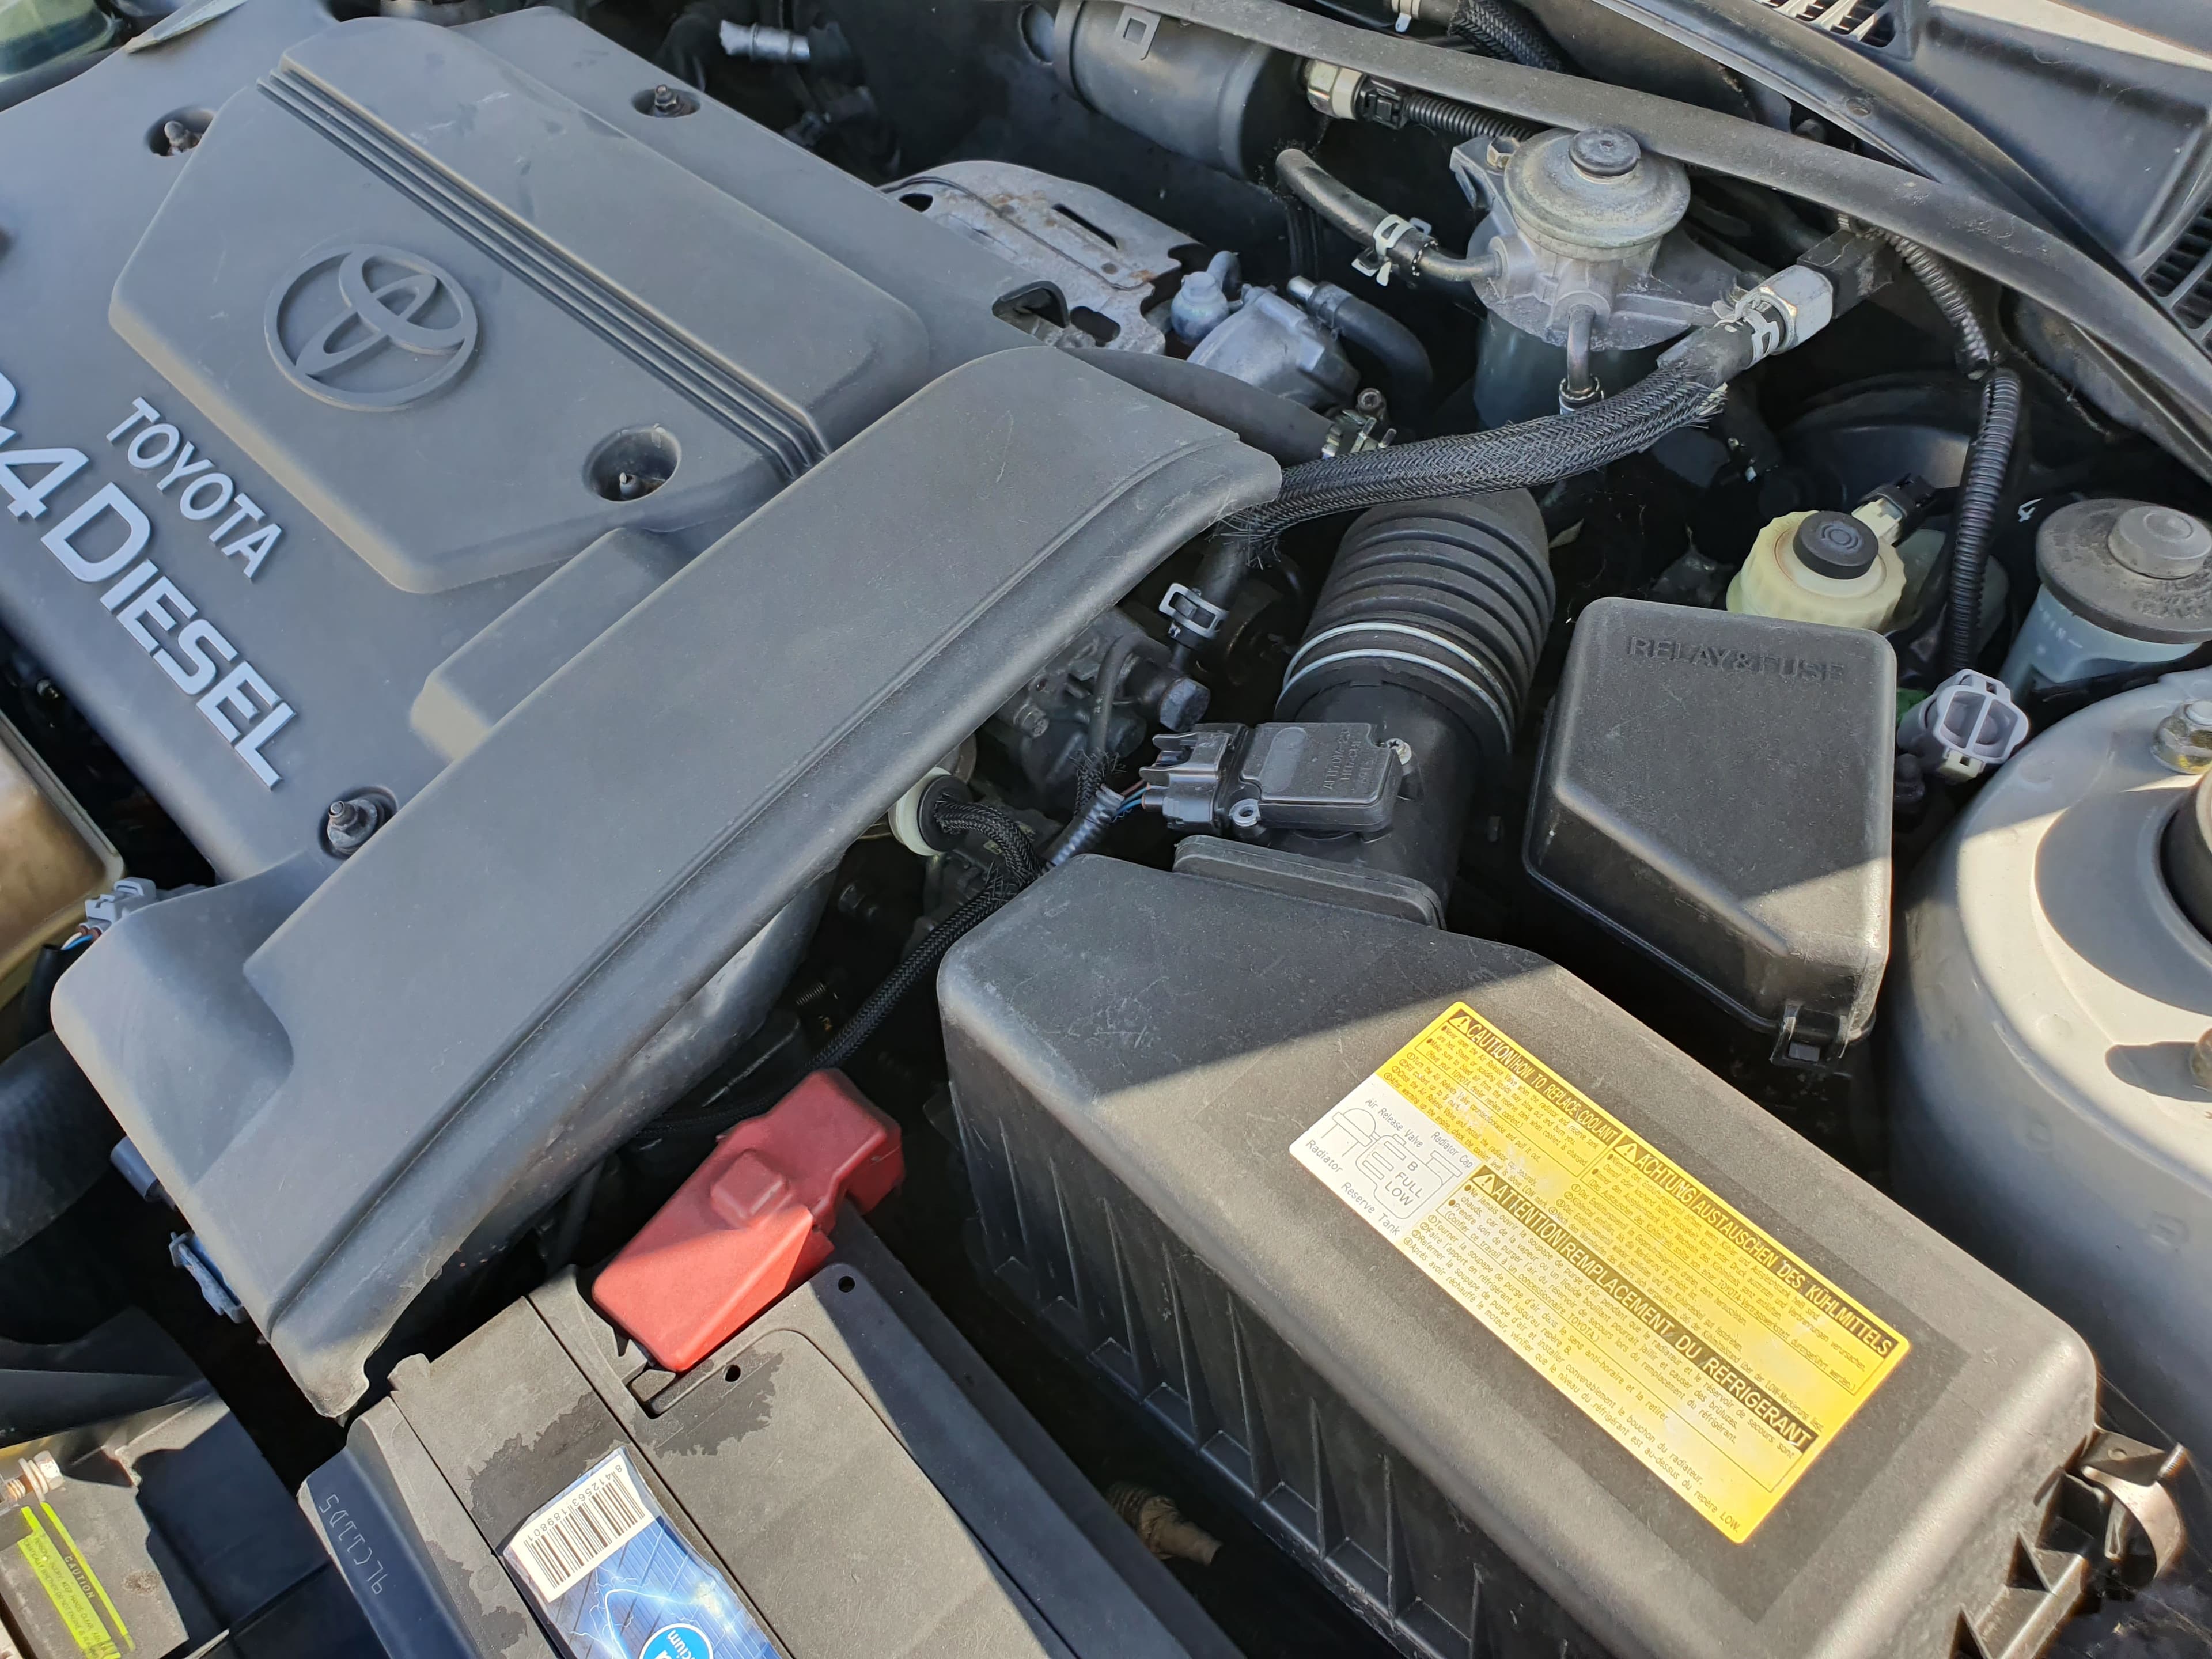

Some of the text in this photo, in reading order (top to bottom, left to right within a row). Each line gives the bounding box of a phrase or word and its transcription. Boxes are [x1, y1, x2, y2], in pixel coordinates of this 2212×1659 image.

[106, 397, 282, 579] TOYOTA
[41, 482, 297, 790] DIESEL
[1364, 1097, 1426, 1148] Air Release Valve
[1464, 1022, 1618, 1143] CAUTION HOW TO REPLACE COOLANT
[1305, 1139, 1345, 1174] Radiator
[1340, 1181, 1403, 1236] Reserve Tank
[1384, 1181, 1414, 1207] LOW
[1394, 1171, 1426, 1199] FULL
[1406, 1160, 1419, 1172] B
[1430, 1131, 1475, 1169] Radiator Cap
[1425, 1227, 1444, 1244] Faire
[1467, 1264, 1478, 1274] en
[1476, 1271, 1514, 1305] réfrigérant
[1539, 1325, 1565, 1348] repère
[1433, 1219, 1460, 1243] Tourner
[1459, 1241, 1468, 1250] la
[1466, 1249, 1494, 1274] soupape
[1494, 1271, 1505, 1281] de
[1503, 1281, 1524, 1299] purge
[1524, 1297, 1541, 1313] d'air
[1540, 1311, 1559, 1328] dans
[1558, 1325, 1568, 1335] le
[1567, 1335, 1584, 1350] sens
[1624, 1382, 1635, 1393] et
[1635, 1391, 1645, 1401] la
[1452, 1202, 1478, 1224] Prendre
[1476, 1222, 1492, 1236] soin
[1491, 1235, 1502, 1245] de
[1500, 1244, 1523, 1264] purger
[1537, 1274, 1549, 1284] du
[1548, 1282, 1579, 1309] réservoir
[1577, 1307, 1589, 1317] de
[1588, 1317, 1614, 1339] secours
[1614, 1338, 1630, 1353] lors
[1629, 1350, 1641, 1362] du
[1639, 1359, 1687, 1401] remplacement
[1686, 1398, 1698, 1409] du
[1469, 1232, 1479, 1241] ce
[1479, 1240, 1502, 1259] travail
[1508, 1264, 1518, 1274] un
[1518, 1272, 1568, 1315] concessionnaire
[1486, 1217, 1498, 1228] car
[1498, 1226, 1509, 1236] de
[1508, 1234, 1517, 1243] la
[1516, 1243, 1539, 1263] vapeur
[1539, 1262, 1549, 1271] ou
[1550, 1270, 1560, 1279] un
[1559, 1277, 1583, 1299] liquide
[1582, 1296, 1612, 1322] bouillant
[1610, 1320, 1640, 1346] pourrait
[1638, 1343, 1659, 1362] jaillir
[1658, 1359, 1669, 1370] et
[1668, 1369, 1692, 1390] causer
[1693, 1388, 1709, 1403] des
[1490, 1181, 1567, 1247] ATTENTION
[1559, 1240, 1675, 1338] REMPLACEMENT
[1673, 1333, 1703, 1361] DU
[1633, 1151, 1895, 1356] ACHTUNG AUSTAUSCHEN DES KÜHLMITTELS
[1408, 1241, 1430, 1262] Après
[1428, 1258, 1448, 1276] avoir
[1446, 1274, 1478, 1302] réchauffé
[1476, 1300, 1486, 1309] le
[1509, 1329, 1536, 1353] vérifier
[1533, 1352, 1548, 1366] que
[1548, 1363, 1559, 1373] le
[1557, 1370, 1582, 1393] niveau
[1580, 1391, 1593, 1403] du
[1590, 1400, 1631, 1437] réfrigérant
[1630, 1433, 1645, 1448] est
[1644, 1446, 1682, 1480] au-dessus
[1681, 1478, 1694, 1491] du
[1692, 1488, 1721, 1515] repère
[1417, 1234, 1447, 1261] Refermer
[1445, 1259, 1456, 1268] la
[1453, 1267, 1480, 1291] soupape
[1480, 1289, 1492, 1300] de
[1490, 1299, 1511, 1318] purge
[1511, 1315, 1529, 1331] d'air
[1527, 1330, 1538, 1340] et
[1537, 1338, 1567, 1364] installer
[1565, 1362, 1618, 1408] convenablement
[1616, 1406, 1627, 1416] le
[1626, 1414, 1658, 1443] bouchon
[1657, 1441, 1669, 1453] du
[1468, 1187, 1796, 1460] Ne jamais ouvrir la soupape de purge d'air pendant que le radiateur et le réservoir de secours sont
[527, 1508, 567, 1541] 189801
[571, 1473, 611, 1506] 412563
[64, 1556, 95, 1599] CAUTION
